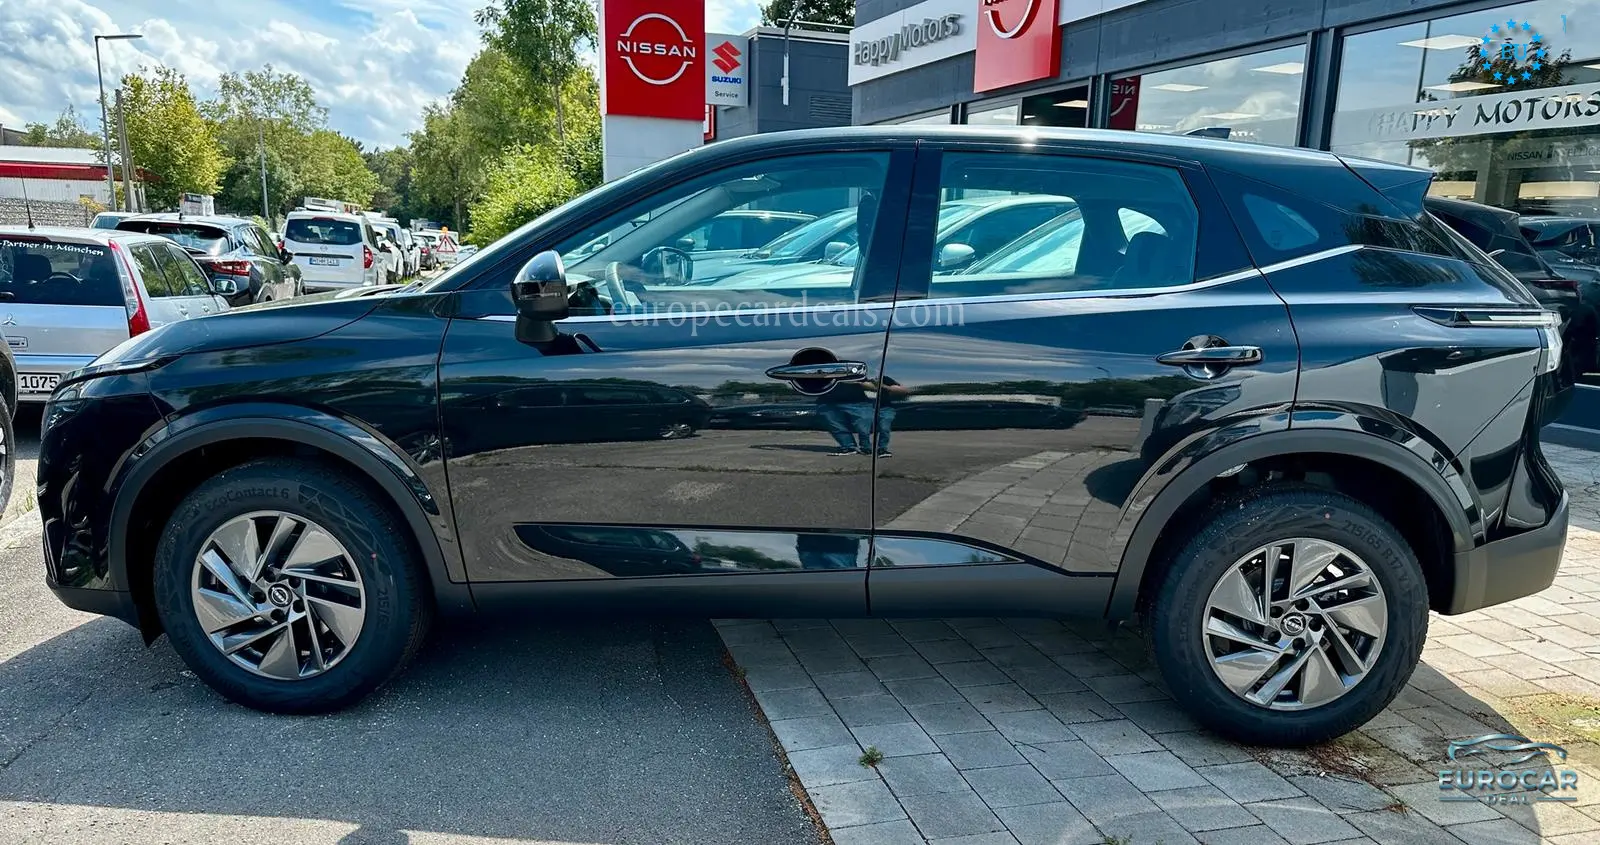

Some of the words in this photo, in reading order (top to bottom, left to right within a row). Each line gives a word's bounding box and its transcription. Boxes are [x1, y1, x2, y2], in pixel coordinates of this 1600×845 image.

[854, 33, 899, 67] Happy
[898, 13, 962, 51] Motors
[617, 40, 696, 58] NISSAN
[711, 75, 742, 85] SUZUKI
[714, 90, 739, 99] Service
[1473, 90, 1600, 127] MOTORS
[1507, 150, 1543, 161] NISSAN
[56, 244, 104, 256] München
[21, 376, 58, 389] 1075
[1343, 519, 1384, 550] 215/65
